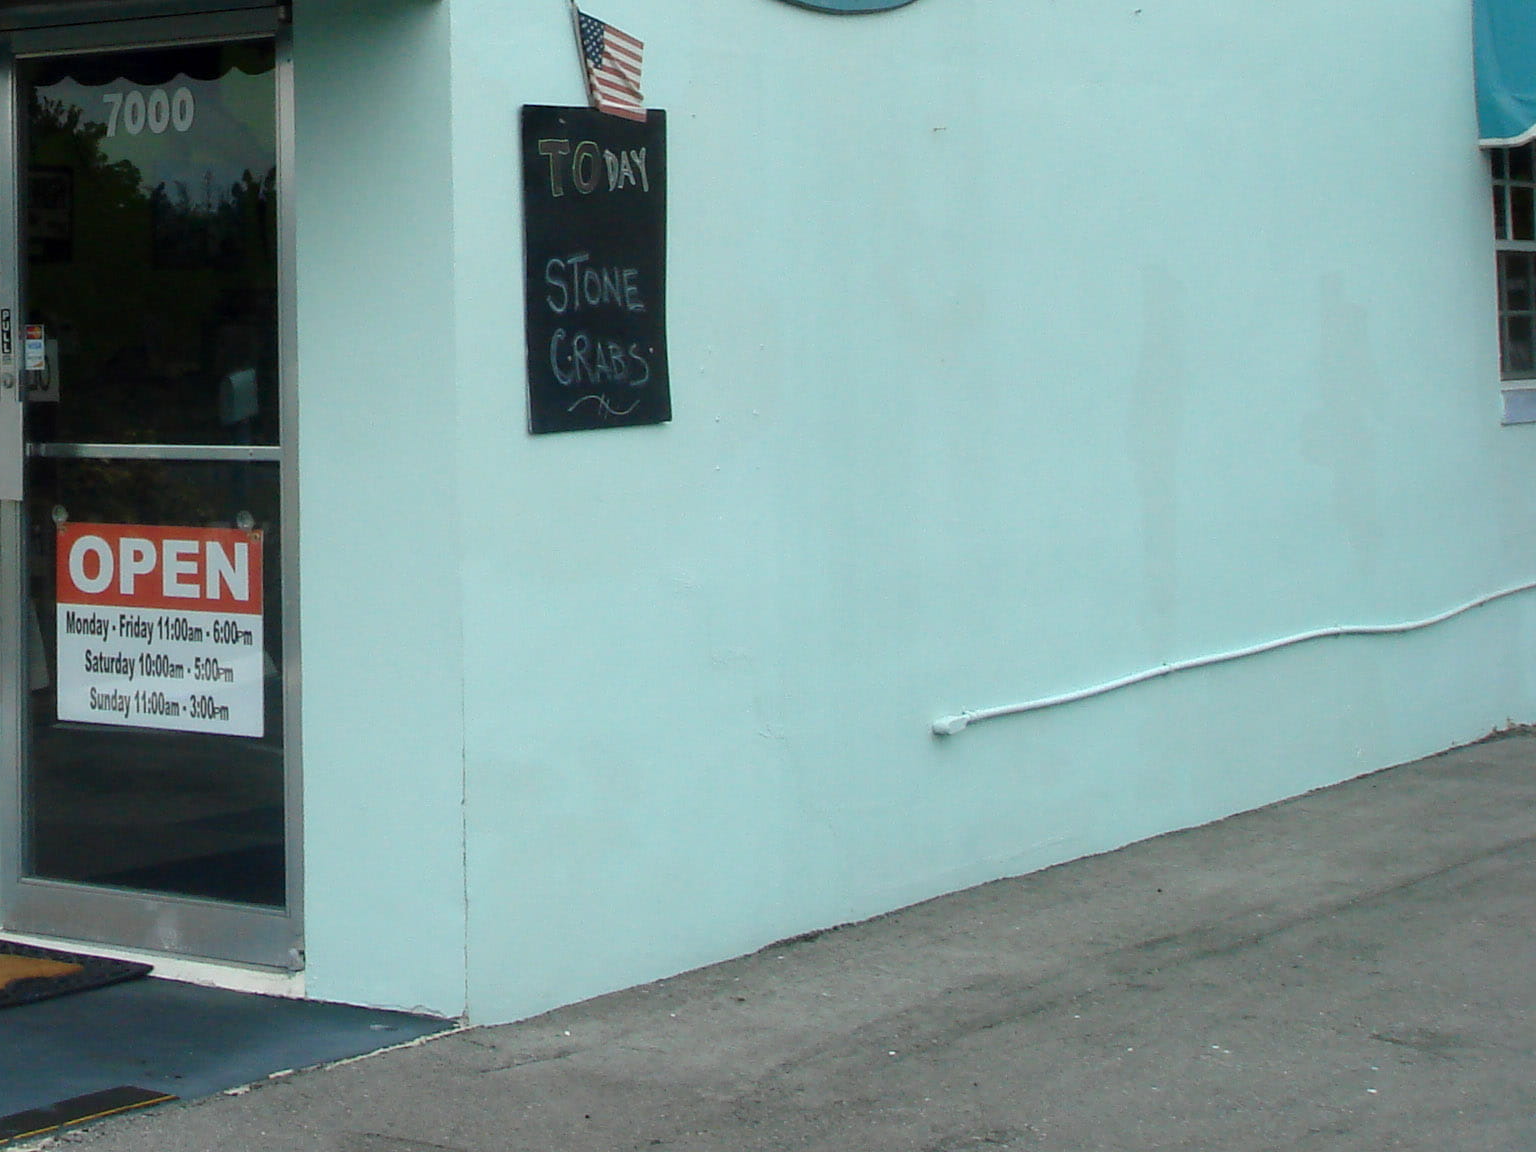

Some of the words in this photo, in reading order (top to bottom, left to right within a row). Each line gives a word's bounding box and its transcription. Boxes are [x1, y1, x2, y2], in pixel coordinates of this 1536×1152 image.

[102, 86, 195, 138] 7000
[545, 252, 646, 314] STONE
[2, 310, 11, 353] PULL
[549, 328, 652, 387] CRABS
[68, 534, 250, 602] OPEN
[66, 611, 109, 642] Monday
[119, 614, 154, 645] Friday
[156, 616, 203, 642] 11:00am
[85, 649, 135, 681] Saturday
[138, 652, 184, 679] 10:00am
[90, 686, 131, 719] Sunday
[134, 690, 180, 717] 11:00am
